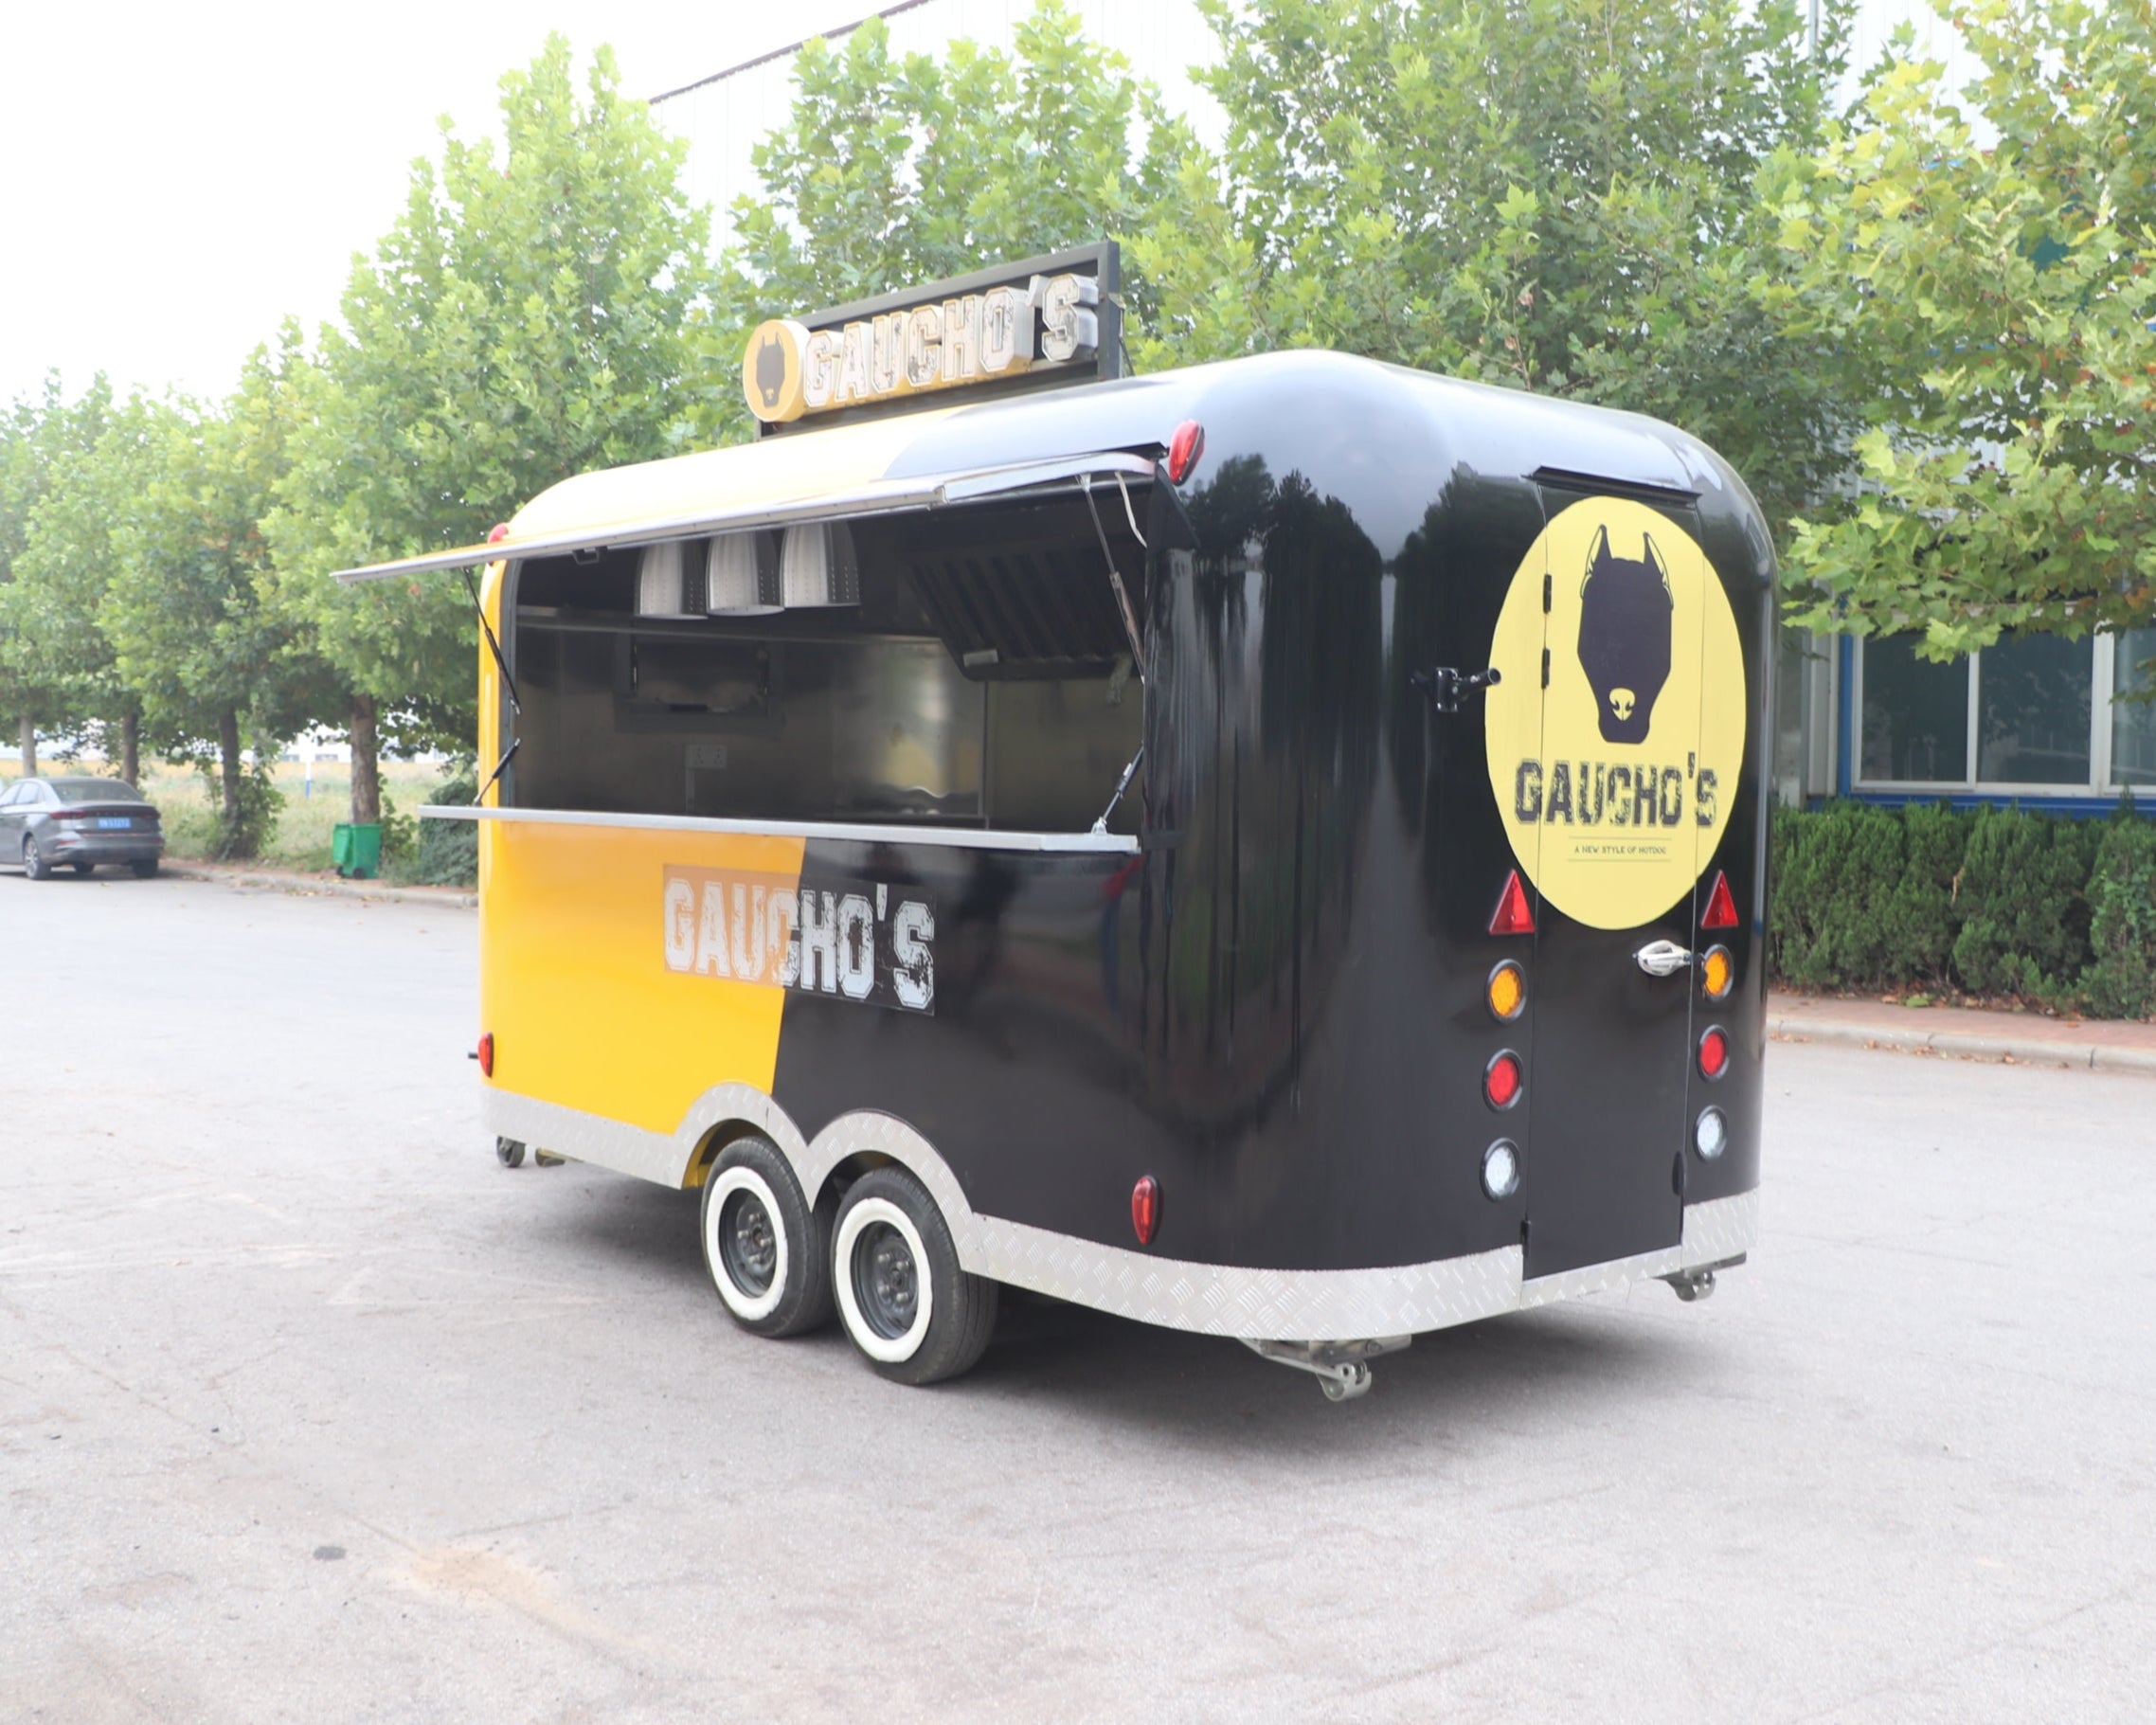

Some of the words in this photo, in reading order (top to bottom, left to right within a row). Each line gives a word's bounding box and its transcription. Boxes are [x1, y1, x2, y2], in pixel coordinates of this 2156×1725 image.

[803, 273, 1094, 408] GAUCHO'S
[1515, 751, 1718, 829] GAUCHO'S
[1574, 845, 1580, 854] A
[1582, 845, 1600, 854] NEW
[1602, 845, 1626, 854] STYLE
[1626, 846, 1637, 854] OF
[664, 877, 935, 1010] GAUCHO'S
